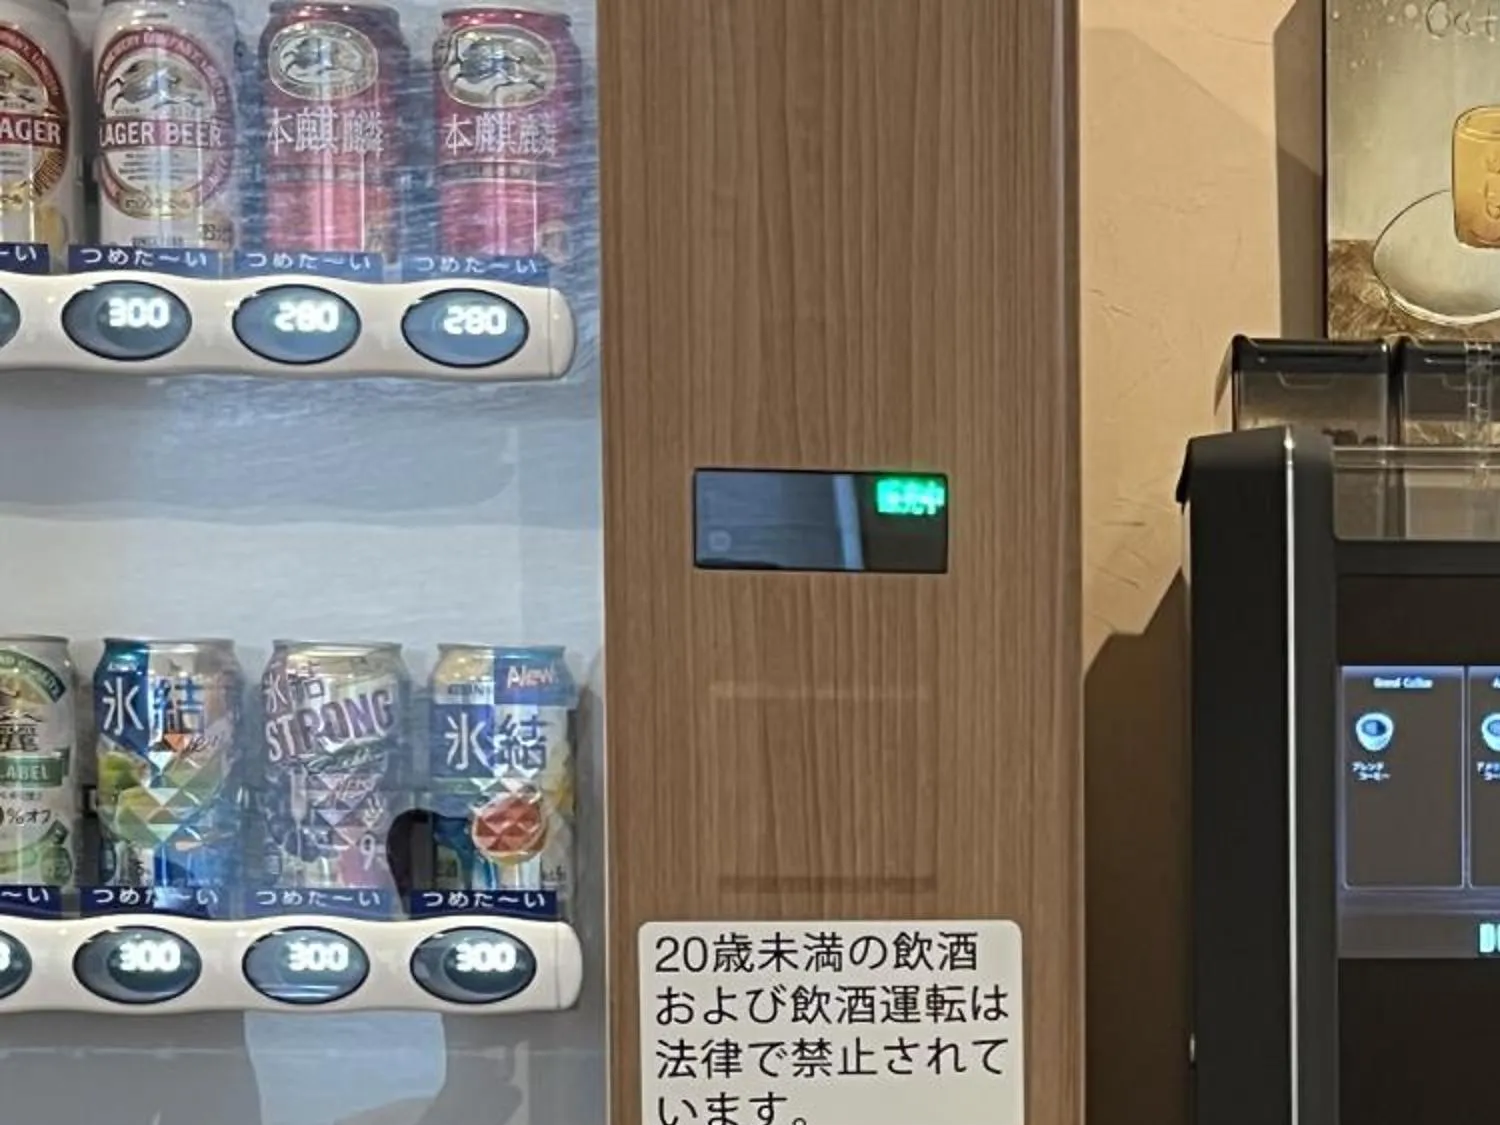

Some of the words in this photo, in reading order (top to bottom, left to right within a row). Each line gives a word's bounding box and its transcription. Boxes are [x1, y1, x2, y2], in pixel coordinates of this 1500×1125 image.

[166, 122, 223, 146] BEER
[267, 106, 384, 156] 本麒麟
[445, 111, 557, 156] 本麒麟
[108, 298, 170, 329] 300
[274, 301, 339, 332] 280
[443, 305, 507, 336] 280
[265, 689, 394, 762] STRONG
[445, 713, 548, 772] 氷結
[118, 940, 181, 972] 300
[287, 940, 349, 972] 300
[455, 940, 517, 973] 300
[655, 931, 979, 973] 20歳未満の飲酒
[655, 983, 1009, 1026] および飲酒運転は
[655, 1036, 1009, 1080] 法律で禁止されて
